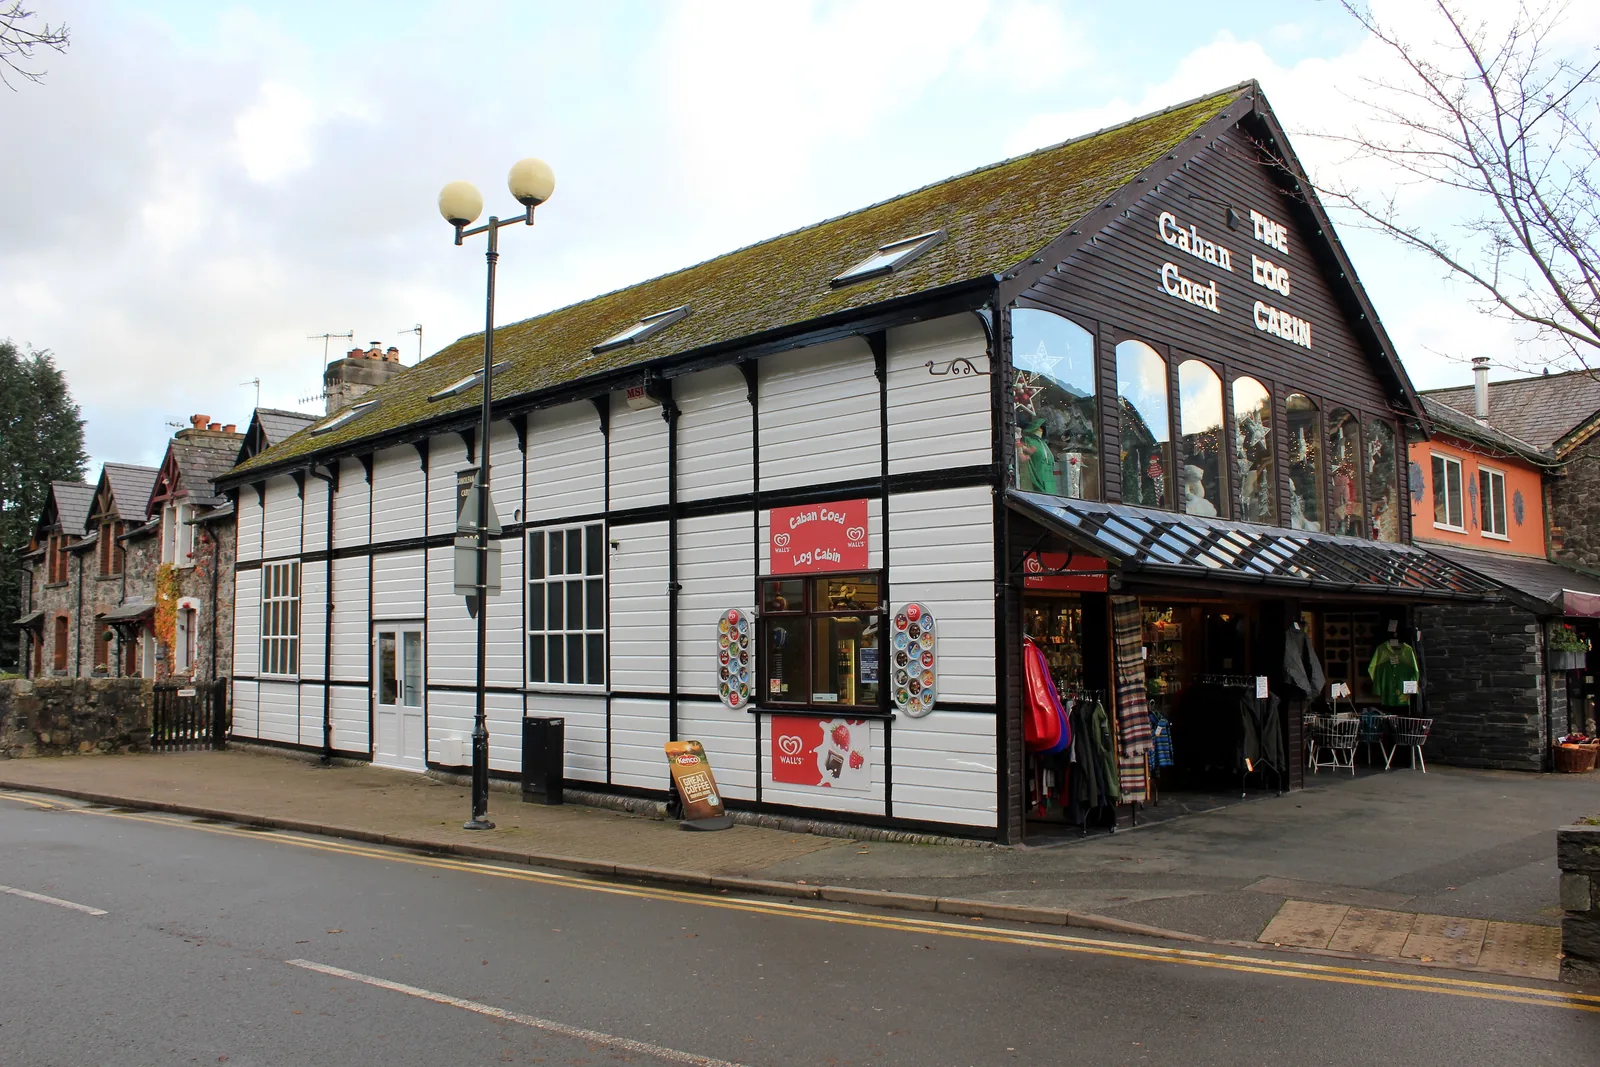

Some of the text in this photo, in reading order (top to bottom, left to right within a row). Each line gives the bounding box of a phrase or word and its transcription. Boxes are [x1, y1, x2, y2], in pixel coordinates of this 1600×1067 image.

[1158, 211, 1234, 272] Caban
[1250, 209, 1289, 255] THE
[1251, 254, 1290, 297] LOG
[1161, 262, 1220, 314] Coed
[1253, 301, 1312, 350] CABIN
[627, 387, 644, 398] MSI
[789, 508, 846, 529] Caban Coed
[793, 548, 841, 566] Log Cabin
[677, 756, 698, 764] Kenco
[780, 755, 802, 765] WALL'S
[683, 773, 705, 786] GREAT
[685, 781, 711, 795] COFFEE
